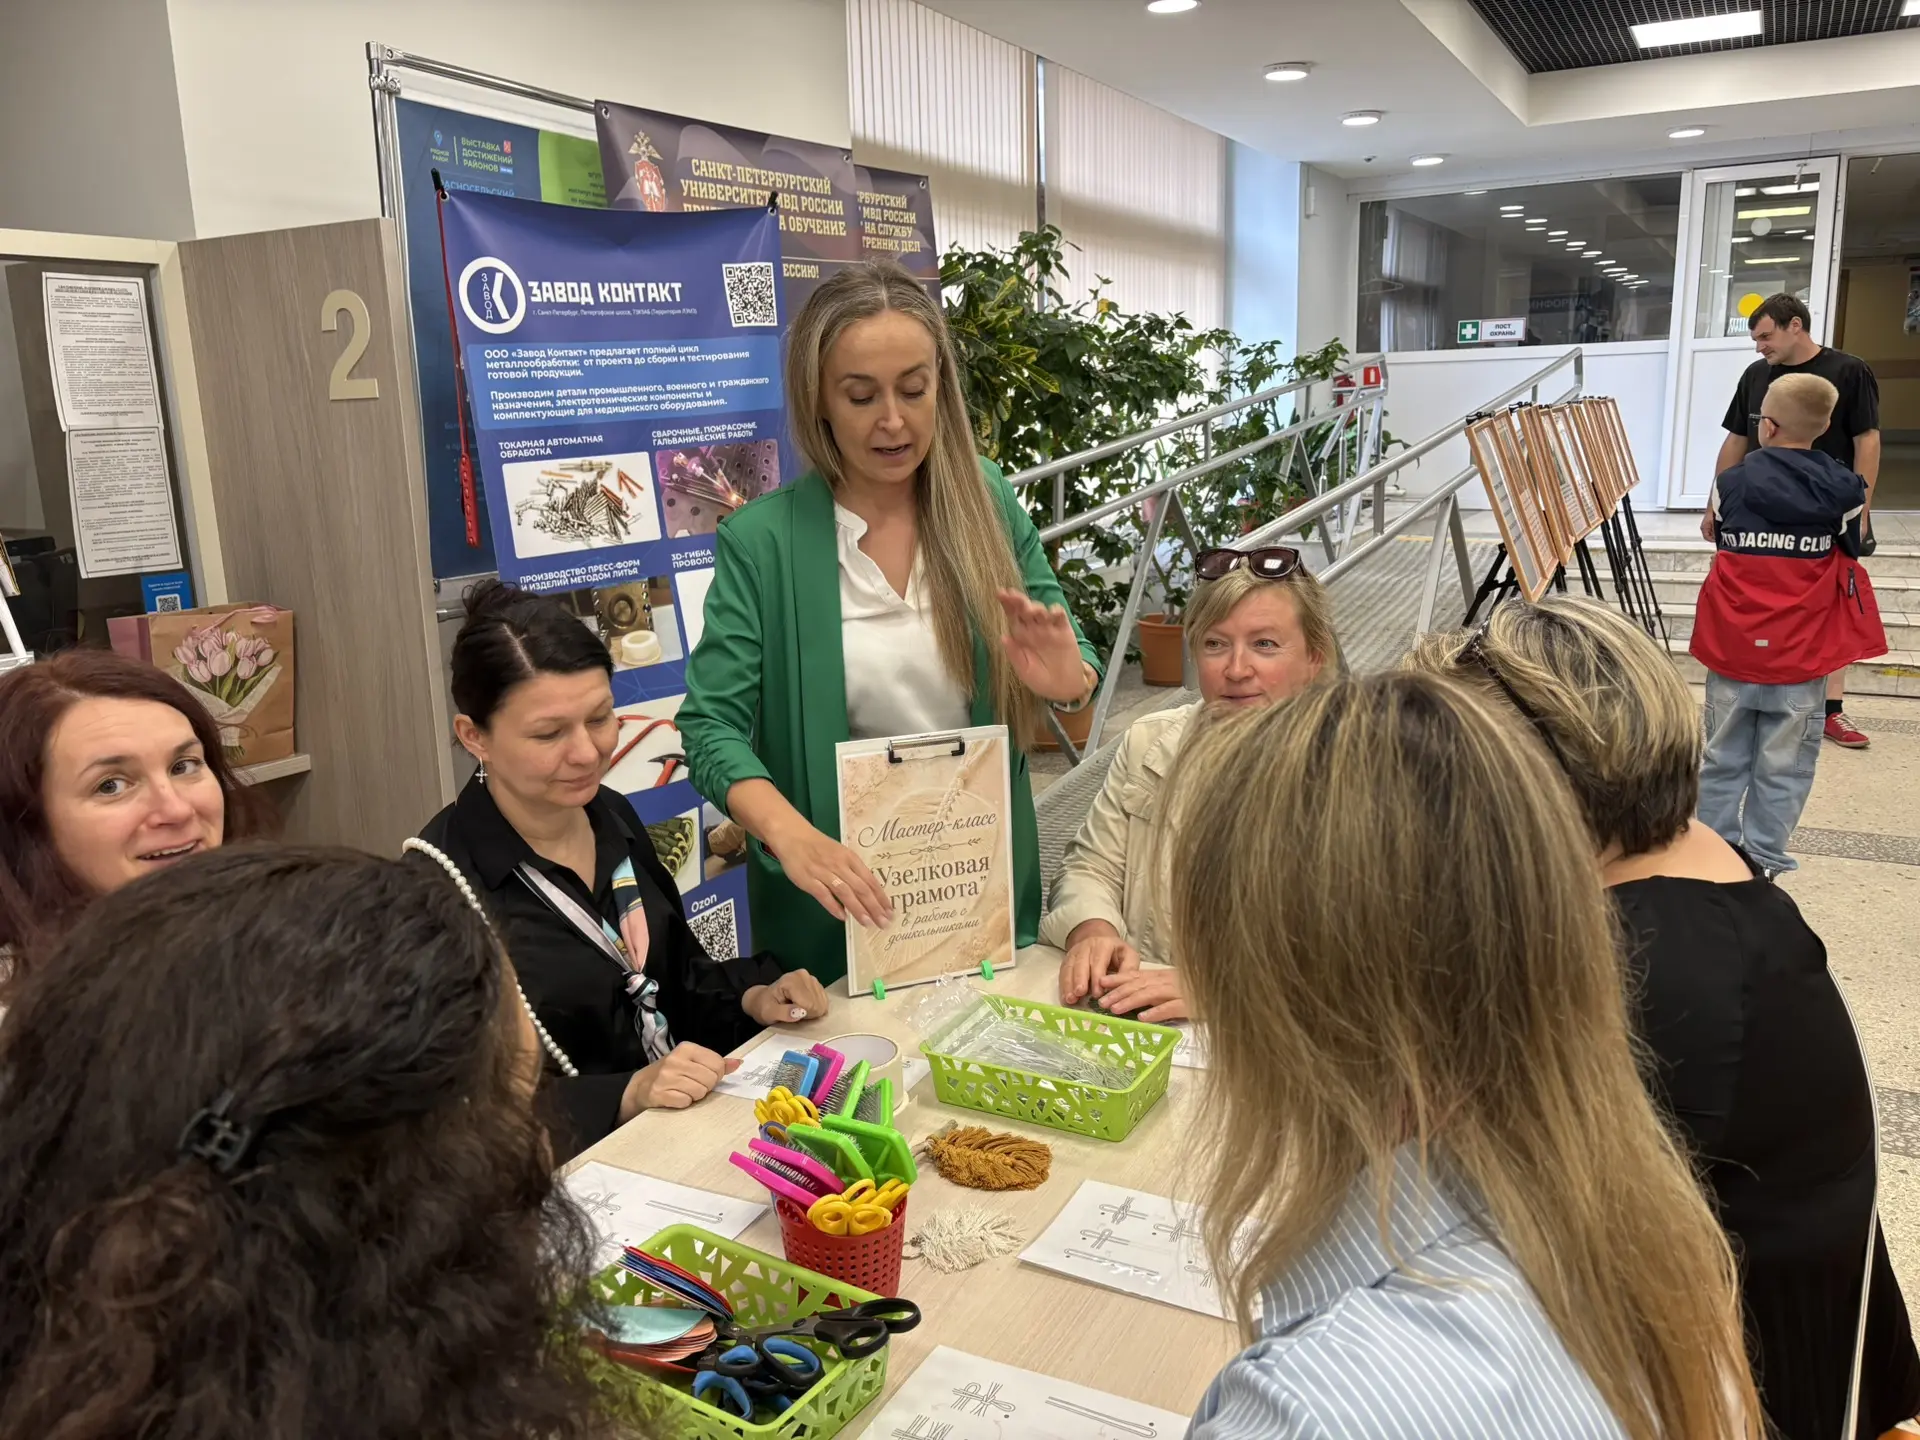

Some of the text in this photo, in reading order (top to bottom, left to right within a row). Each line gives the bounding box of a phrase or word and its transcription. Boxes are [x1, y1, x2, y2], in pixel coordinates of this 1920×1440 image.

[461, 137, 500, 151] ВЫСТАВКА
[462, 148, 513, 165] ДОСТИЖЕНИЙ
[463, 159, 498, 172] РАЙОНОВ
[691, 158, 831, 195] САНКТ-ПЕТЕРБУРГСКИЙ
[443, 180, 515, 197] АСНОСЕЛЬСКИЙ
[680, 179, 770, 206] УНИВЕРСИТЕТ
[801, 197, 844, 216] РОССИИ
[863, 206, 916, 224] МВД РОССИИ
[779, 214, 846, 236] А ОБУЧЕНИЕ
[864, 221, 912, 238] НА СЛУЖБУ
[862, 235, 921, 252] ТРЕННИХ ДЕЛ
[782, 263, 820, 279] ЕССИЮ!
[528, 281, 682, 305] ЗАВОД КОНТАКТ
[321, 289, 379, 401] 2
[484, 345, 699, 358] ООО «Завод Контакт» предлагает полный цикл
[486, 358, 580, 369] металлообработки:
[583, 357, 594, 366] от
[595, 357, 632, 368] проекта
[634, 356, 645, 365] до
[647, 355, 678, 366] сборки
[687, 351, 750, 361] тестирования
[487, 369, 584, 380] готовой продукции.
[490, 389, 554, 402] Производим
[556, 388, 587, 398] детали
[589, 384, 665, 397] промышленного,
[666, 382, 707, 391] военного
[717, 377, 769, 389] гражданского
[492, 401, 554, 411] назначения,
[555, 394, 648, 407] электротехнические
[650, 391, 703, 401] компоненты
[493, 399, 727, 421] комплектующие для медицинского оборудования.
[498, 434, 603, 449] ТОКАРНАЯ АВТОМАТНАЯ
[653, 430, 753, 446] ГАЛЬВАНИЧЕСКИЕ РАБОТЫ
[500, 448, 552, 459] ОБРАБОТКА
[1738, 532, 1796, 551] RACING
[1799, 534, 1832, 552] CLUB
[671, 549, 712, 561] 3D-ГИБКА
[673, 556, 715, 568] ПРОВОЛО
[519, 559, 640, 584] ПРОИЗВОДСТВО ПРЕСС-ФОРМ
[520, 567, 638, 592] И ИЗДЕЛИЙ МЕТОДОМ ЛИТЬЯ
[858, 813, 997, 848] Мастер-класс
[691, 894, 718, 913] Ozon
[901, 906, 968, 930] в работе с
[884, 918, 980, 951] дошкольниками
